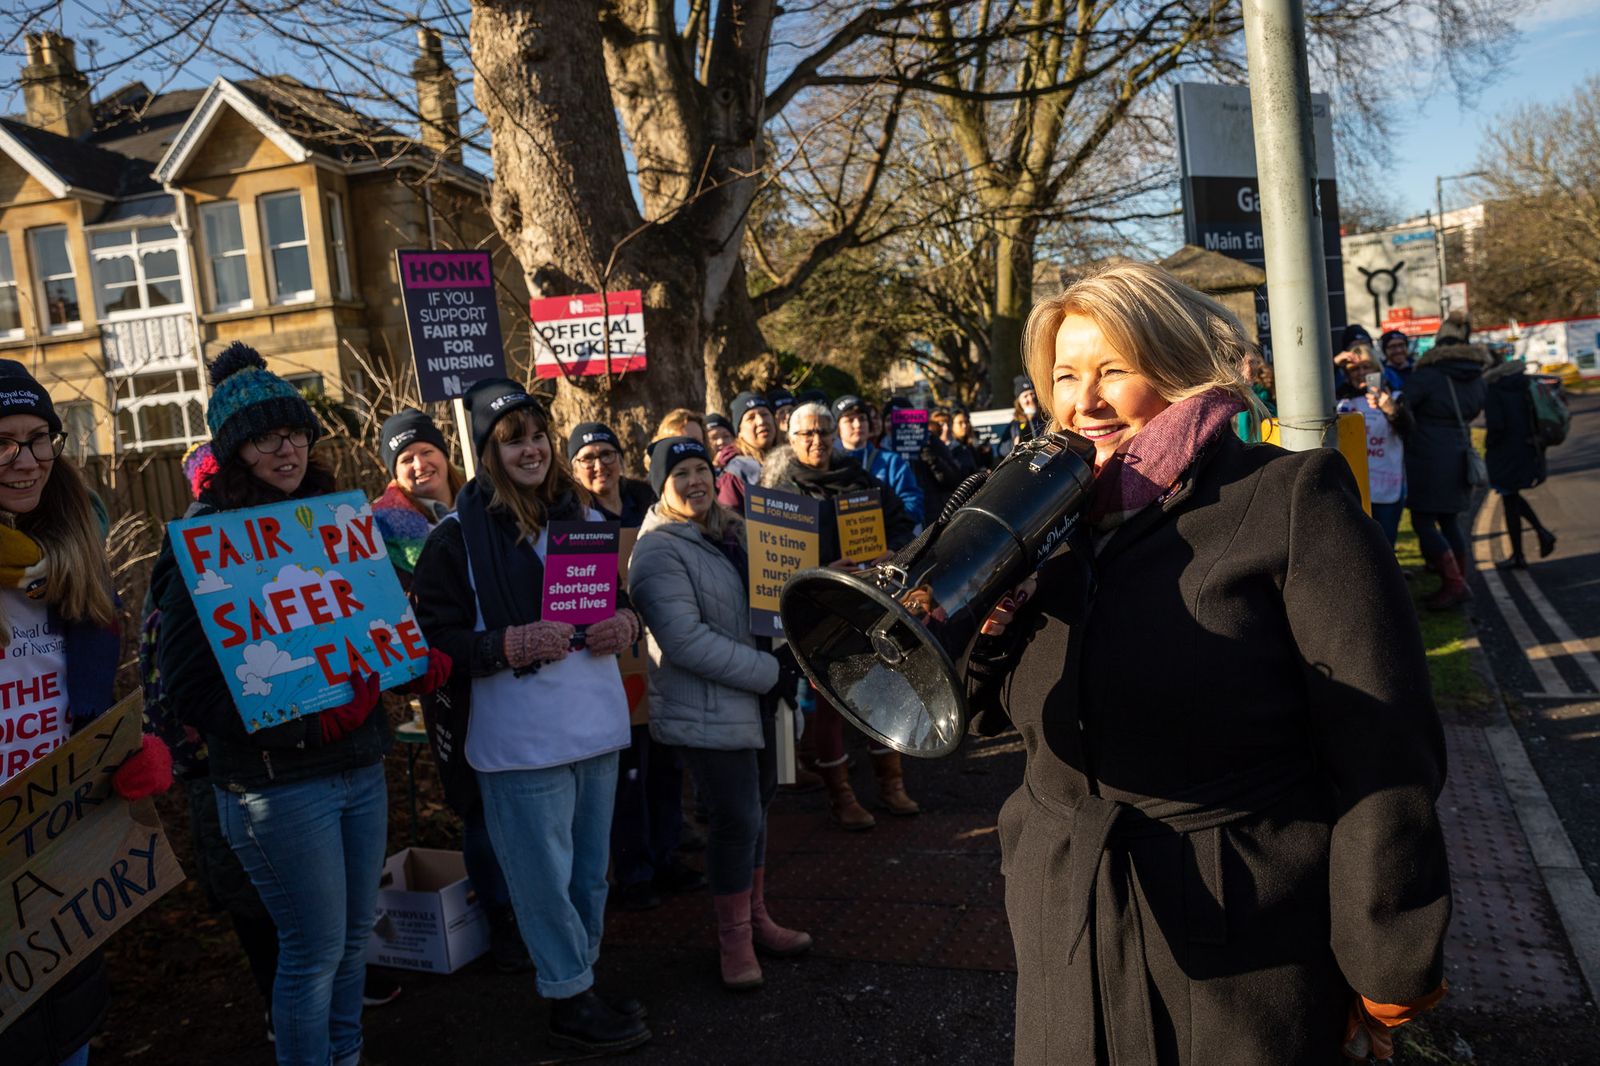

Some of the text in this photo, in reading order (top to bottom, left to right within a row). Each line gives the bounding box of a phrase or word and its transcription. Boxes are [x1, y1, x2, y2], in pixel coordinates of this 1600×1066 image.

[1204, 232, 1242, 250] Main
[409, 261, 485, 283] HONK
[428, 291, 474, 306] IF YOU
[420, 307, 487, 323] SUPPORT
[423, 322, 488, 339] FAIR PAY
[541, 319, 637, 342] OFFICAL
[444, 339, 475, 355] FOR
[553, 338, 627, 358] PICKET
[427, 354, 495, 372] NURSING
[766, 498, 800, 513] FAIR PAY
[766, 508, 815, 525] FOR NURSING
[183, 515, 378, 574] FAIR PAY
[759, 530, 807, 551] It's time
[766, 550, 801, 569] to pay
[566, 565, 597, 577] Staff
[762, 567, 793, 582] nursi
[549, 582, 610, 595] shortages
[550, 597, 607, 611] cost lives
[213, 579, 365, 649] SAFER
[13, 622, 39, 641] Royal
[13, 642, 28, 657] of
[313, 620, 429, 687] CARE
[0, 671, 60, 709] THE
[13, 870, 65, 929] A
[0, 833, 158, 1004] OSITORY
